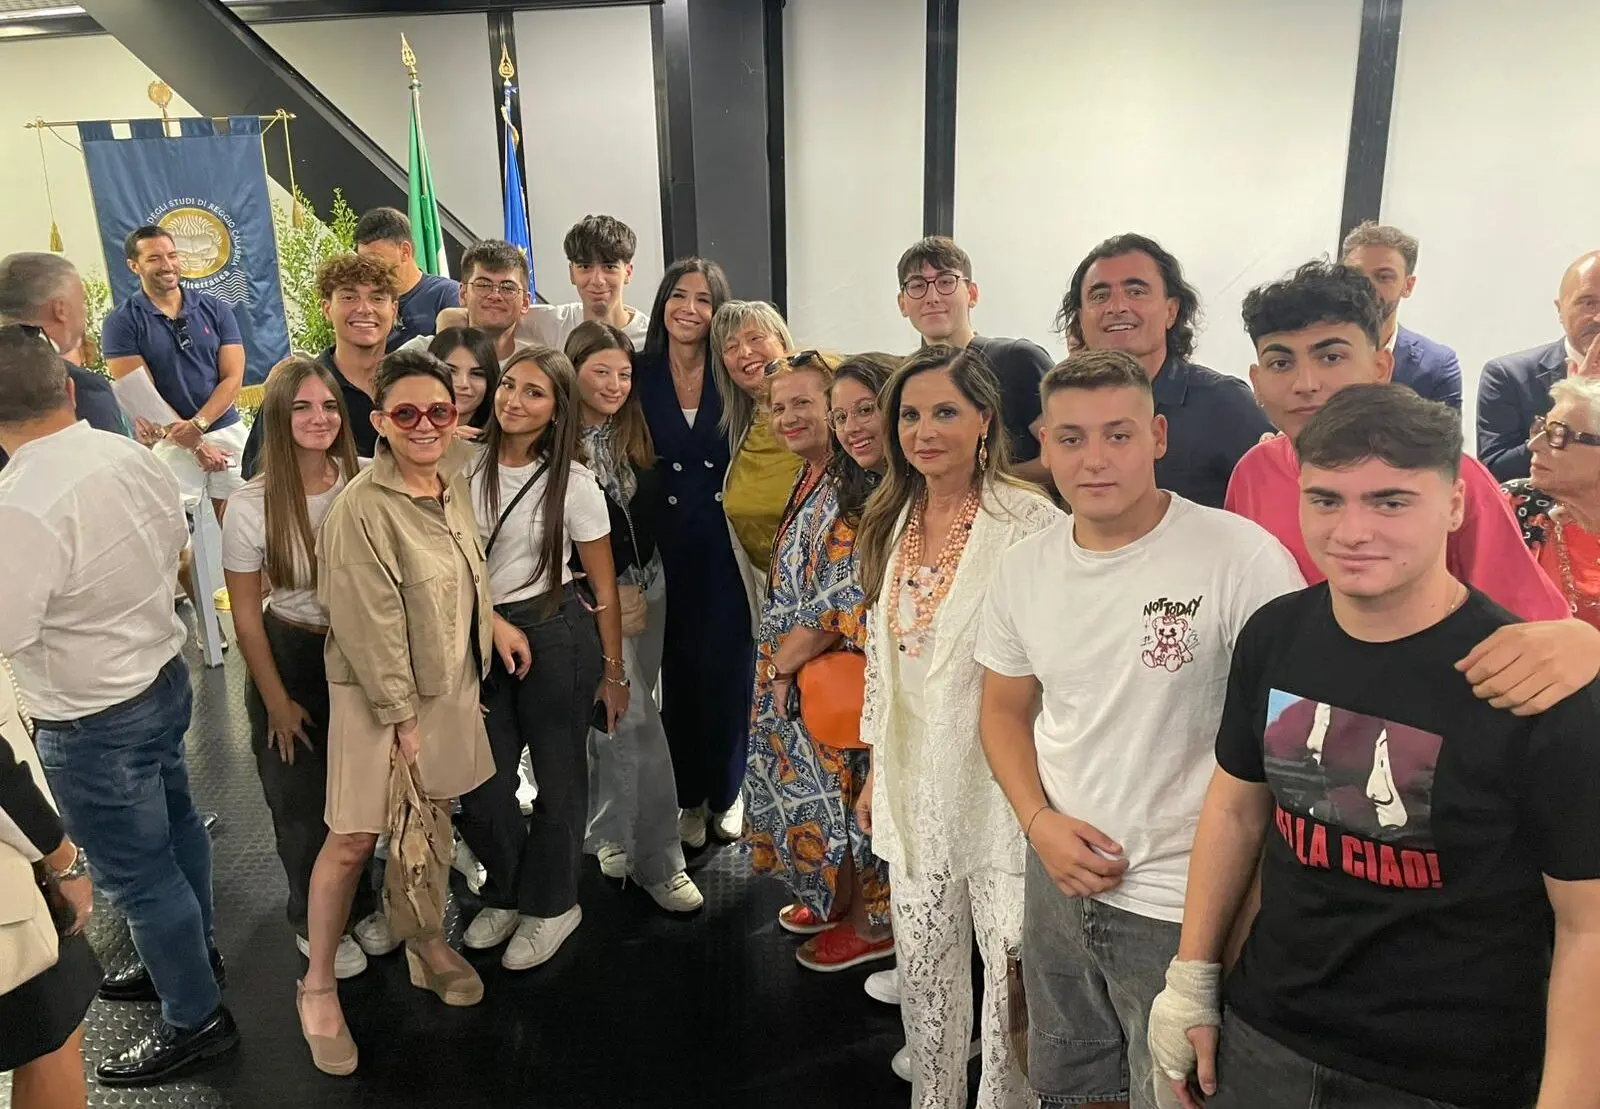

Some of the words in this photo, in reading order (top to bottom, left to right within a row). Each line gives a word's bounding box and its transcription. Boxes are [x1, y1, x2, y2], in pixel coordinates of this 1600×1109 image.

[146, 203, 169, 224] DEGLI
[169, 198, 195, 208] STUDI
[197, 199, 207, 207] DI
[208, 203, 236, 229] REGGIO
[230, 229, 242, 267] CALABRIA
[180, 270, 231, 289] diterranea
[1143, 597, 1168, 616] NOT
[1164, 595, 1203, 617] TODAY
[1341, 834, 1443, 889] CIAO!
